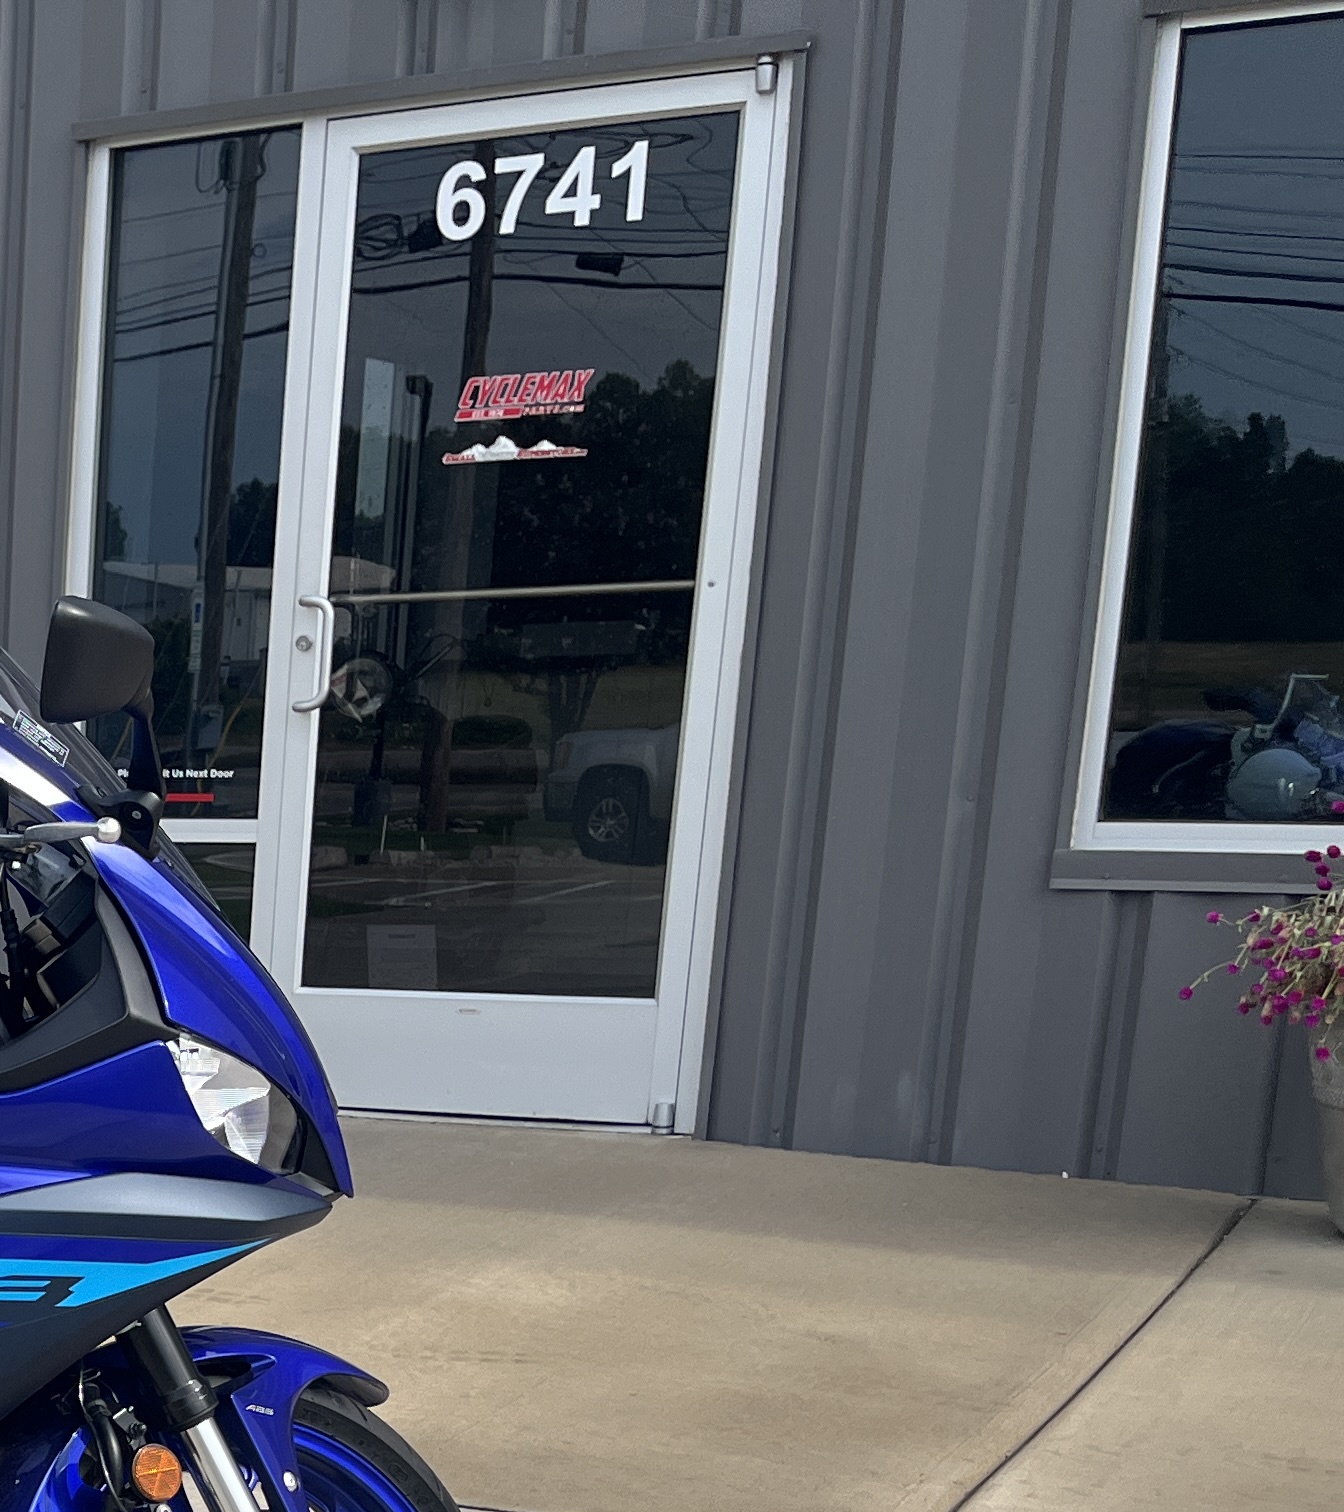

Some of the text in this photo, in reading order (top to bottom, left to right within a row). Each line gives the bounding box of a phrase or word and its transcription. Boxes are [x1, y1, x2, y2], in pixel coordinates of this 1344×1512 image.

[435, 139, 649, 242] 6741
[458, 368, 595, 409] CYCLEMAX
[172, 769, 183, 777] Us
[186, 769, 208, 777] Next
[210, 769, 234, 777] Door
